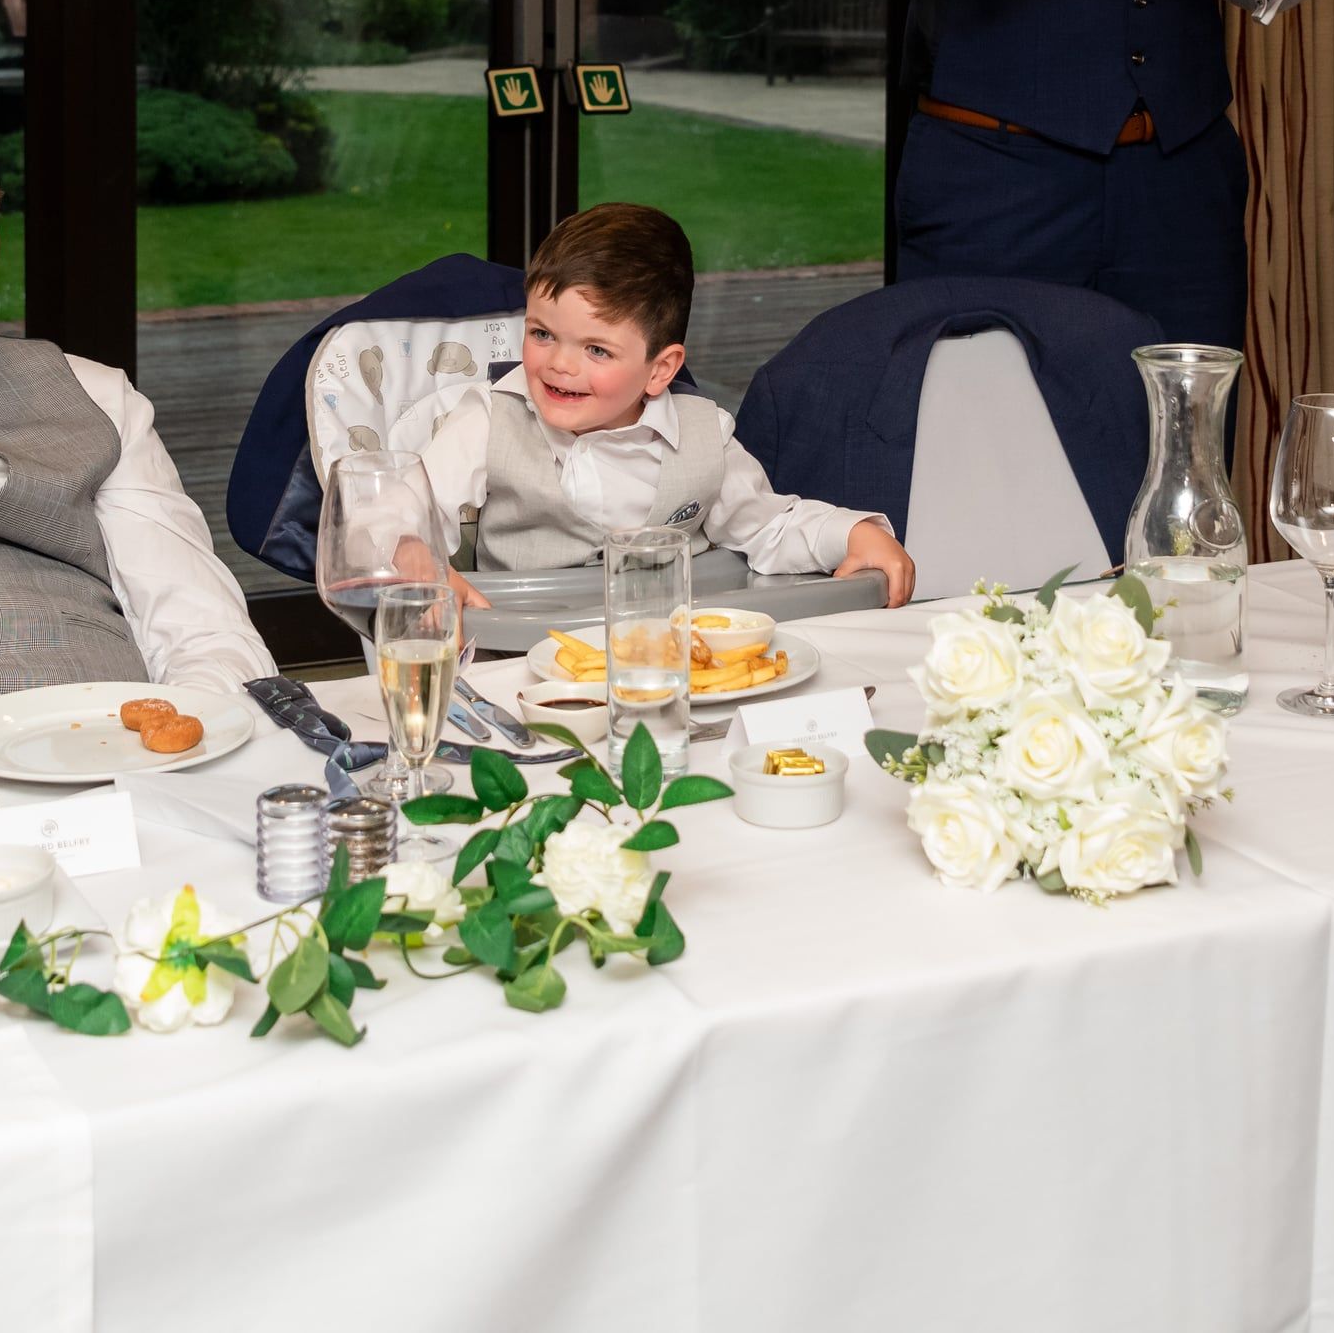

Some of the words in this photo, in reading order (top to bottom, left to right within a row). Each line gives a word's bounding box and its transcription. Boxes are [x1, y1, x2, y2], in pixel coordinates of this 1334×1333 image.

[484, 322, 507, 332] bear
[492, 336, 505, 345] my
[491, 348, 511, 358] love
[336, 354, 349, 378] bear
[57, 837, 91, 848] BELFRY
